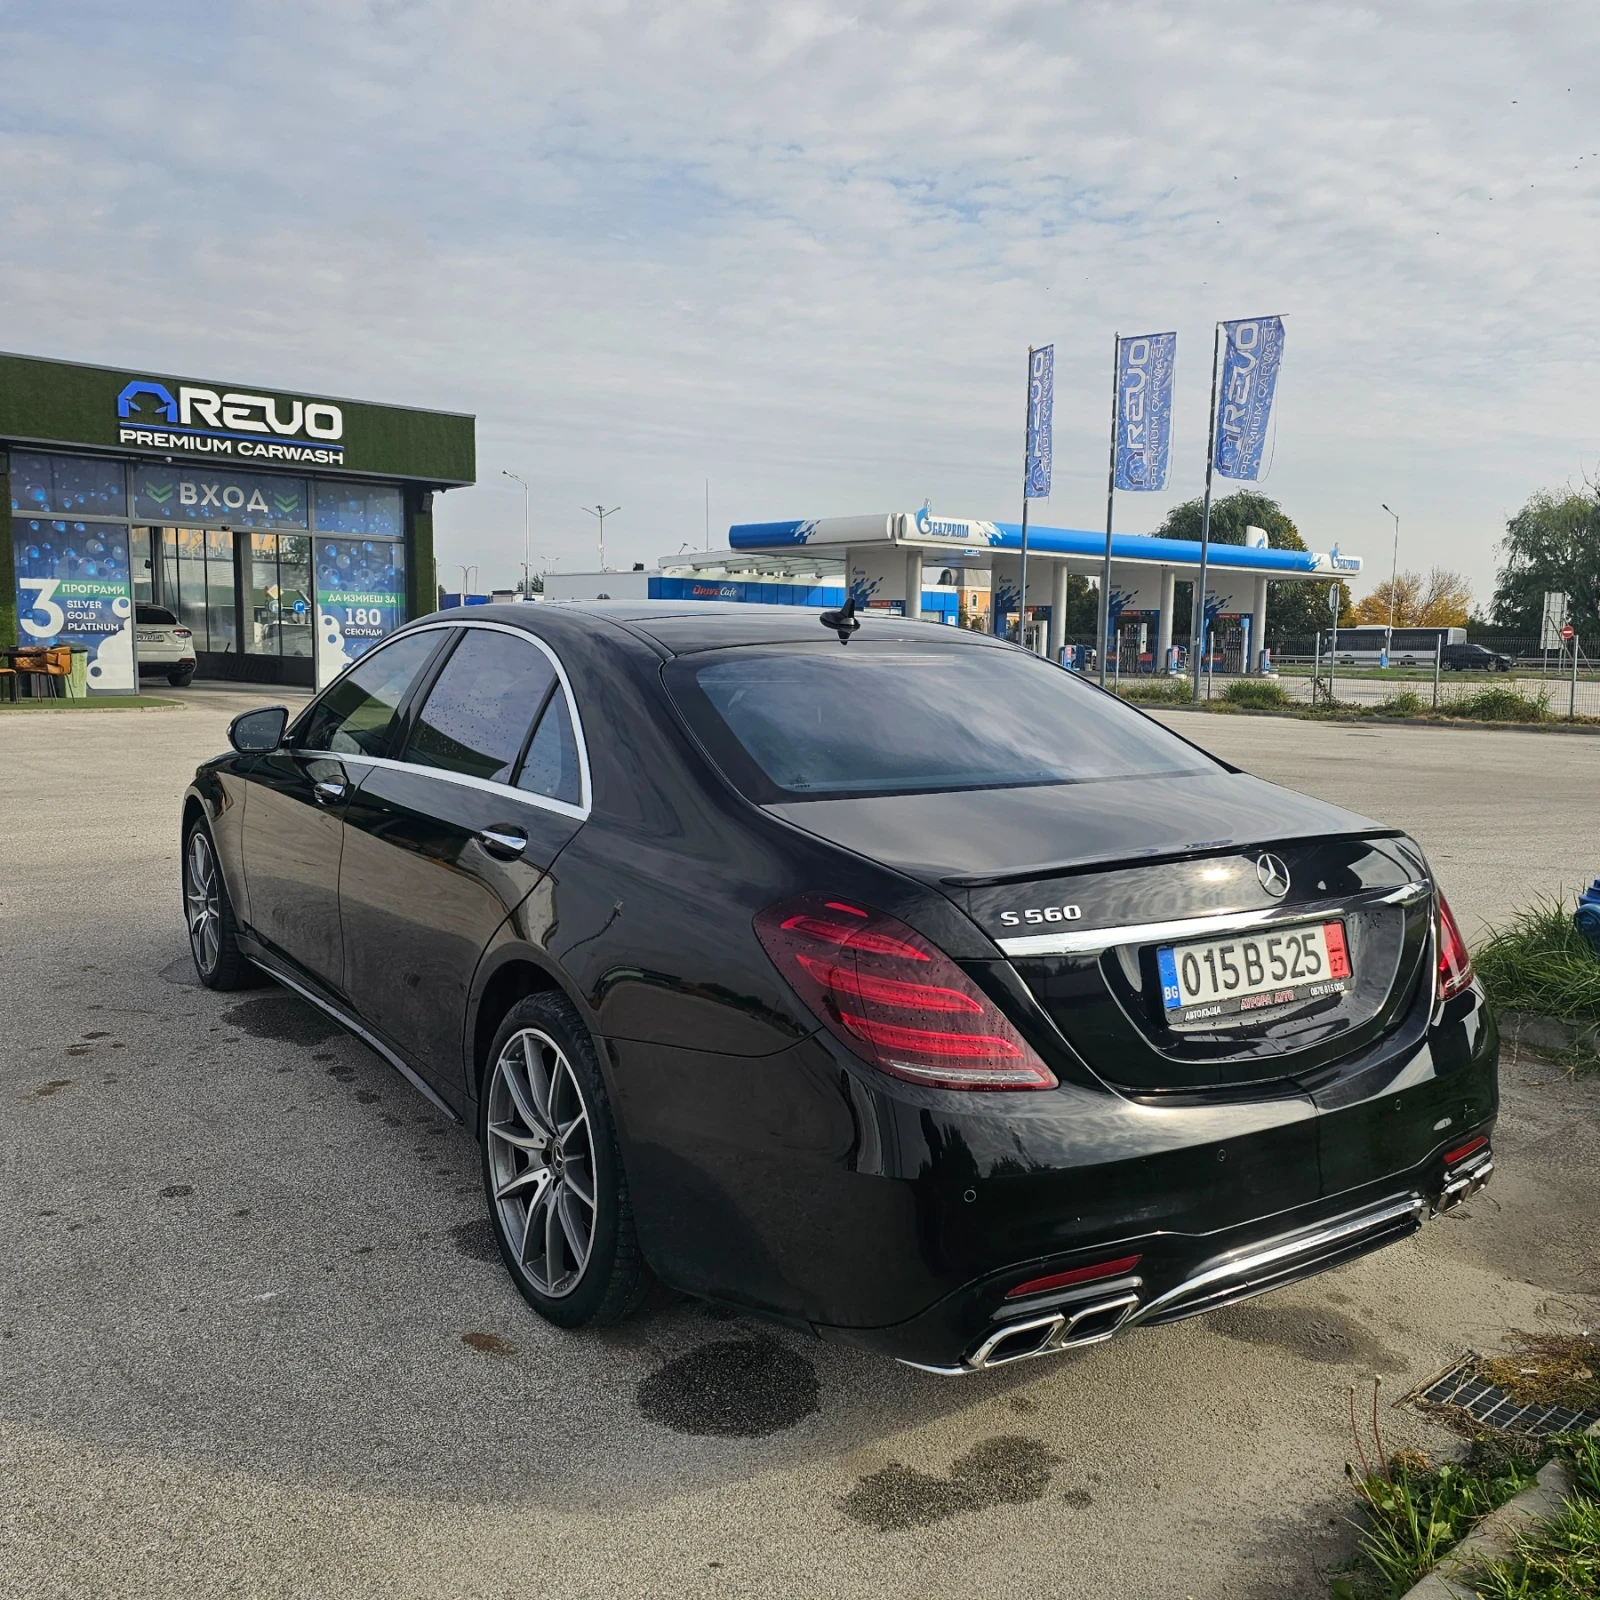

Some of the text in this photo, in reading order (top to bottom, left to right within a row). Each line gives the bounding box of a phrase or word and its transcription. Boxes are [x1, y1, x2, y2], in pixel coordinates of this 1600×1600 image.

[1126, 339, 1150, 449] REVO
[1240, 317, 1280, 475] PREMIUM CARWASH
[179, 386, 344, 441] REVO
[1150, 337, 1165, 486] PREMIUM CARWASH
[119, 429, 344, 465] PREMIUM CARWASH
[179, 482, 269, 513] ВХОД
[932, 521, 969, 538] GAZPROM
[61, 583, 125, 595] ПРОГРАМИ
[67, 600, 102, 609] SILVER
[328, 594, 397, 603] ДА ИЗМИЕШ ЗА
[19, 578, 65, 638] 3
[67, 611, 96, 620] GOLD
[345, 608, 382, 626] 180
[68, 622, 119, 631] PLATINUM
[345, 628, 383, 636] СЕКУНДИ
[1001, 904, 1082, 926] S 560
[1331, 956, 1344, 972] 27
[1164, 985, 1179, 1000] BG
